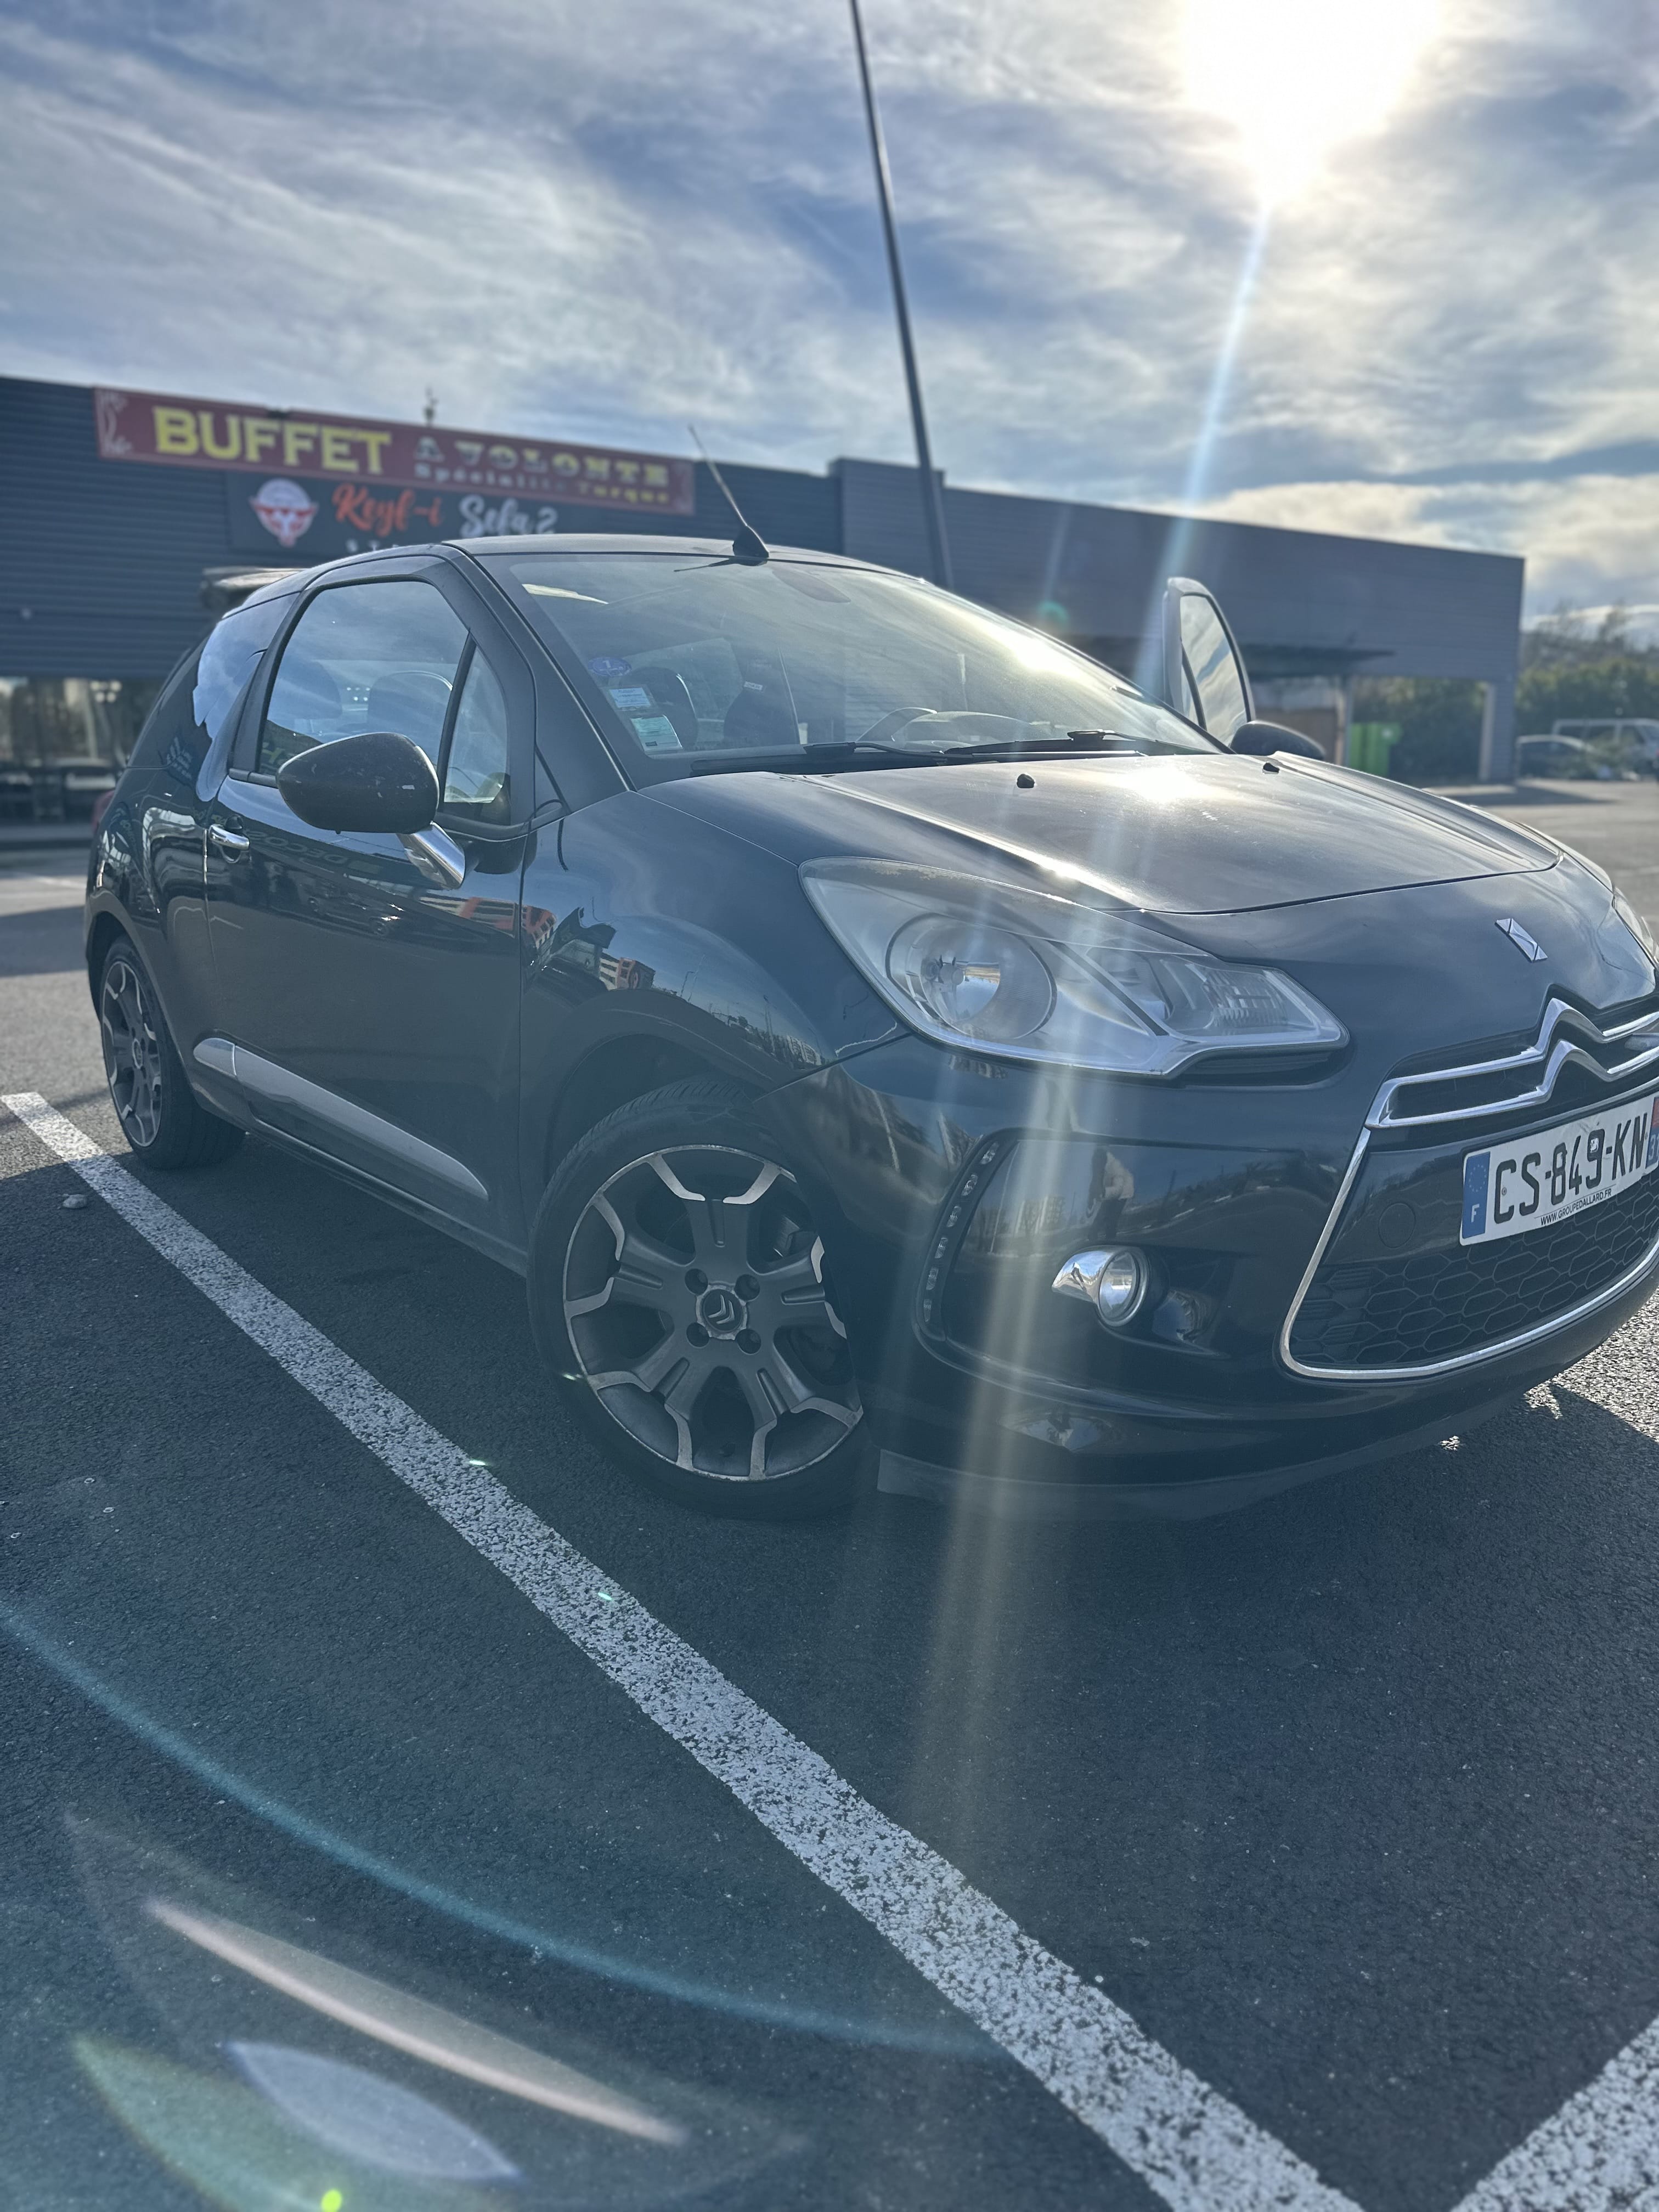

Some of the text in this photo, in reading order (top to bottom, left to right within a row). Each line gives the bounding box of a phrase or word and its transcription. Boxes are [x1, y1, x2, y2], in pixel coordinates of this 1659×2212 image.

[153, 407, 391, 474] BUFFET
[1494, 1113, 1648, 1224] CS-849-KN
[1471, 1204, 1480, 1222] F
[1540, 1188, 1612, 1226] WWW.GROUPEDALLARD.FR
